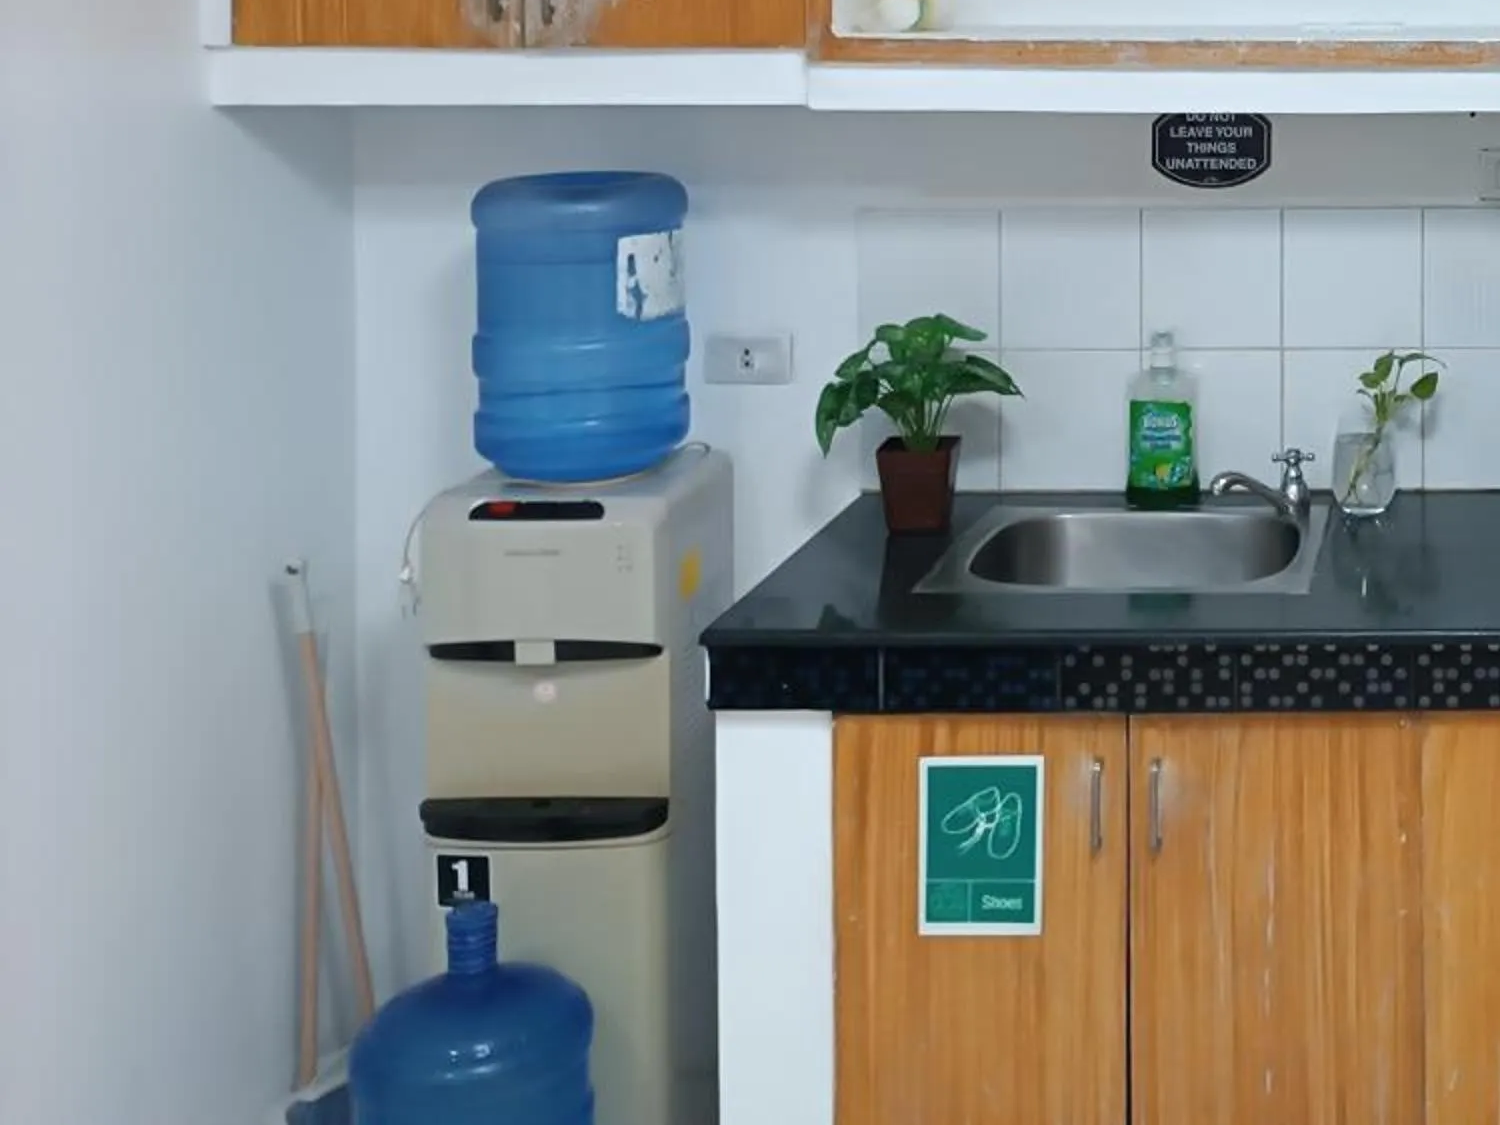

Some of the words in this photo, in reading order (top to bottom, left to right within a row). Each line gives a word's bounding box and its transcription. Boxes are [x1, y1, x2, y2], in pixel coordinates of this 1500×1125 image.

[1185, 113, 1206, 122] DO
[1209, 113, 1236, 122] NOT
[1169, 126, 1213, 138] LEAVE
[1215, 126, 1253, 138] YOUR
[1186, 142, 1237, 154] THINGS
[1165, 158, 1257, 170] UNATTENDED
[451, 859, 469, 892] 1
